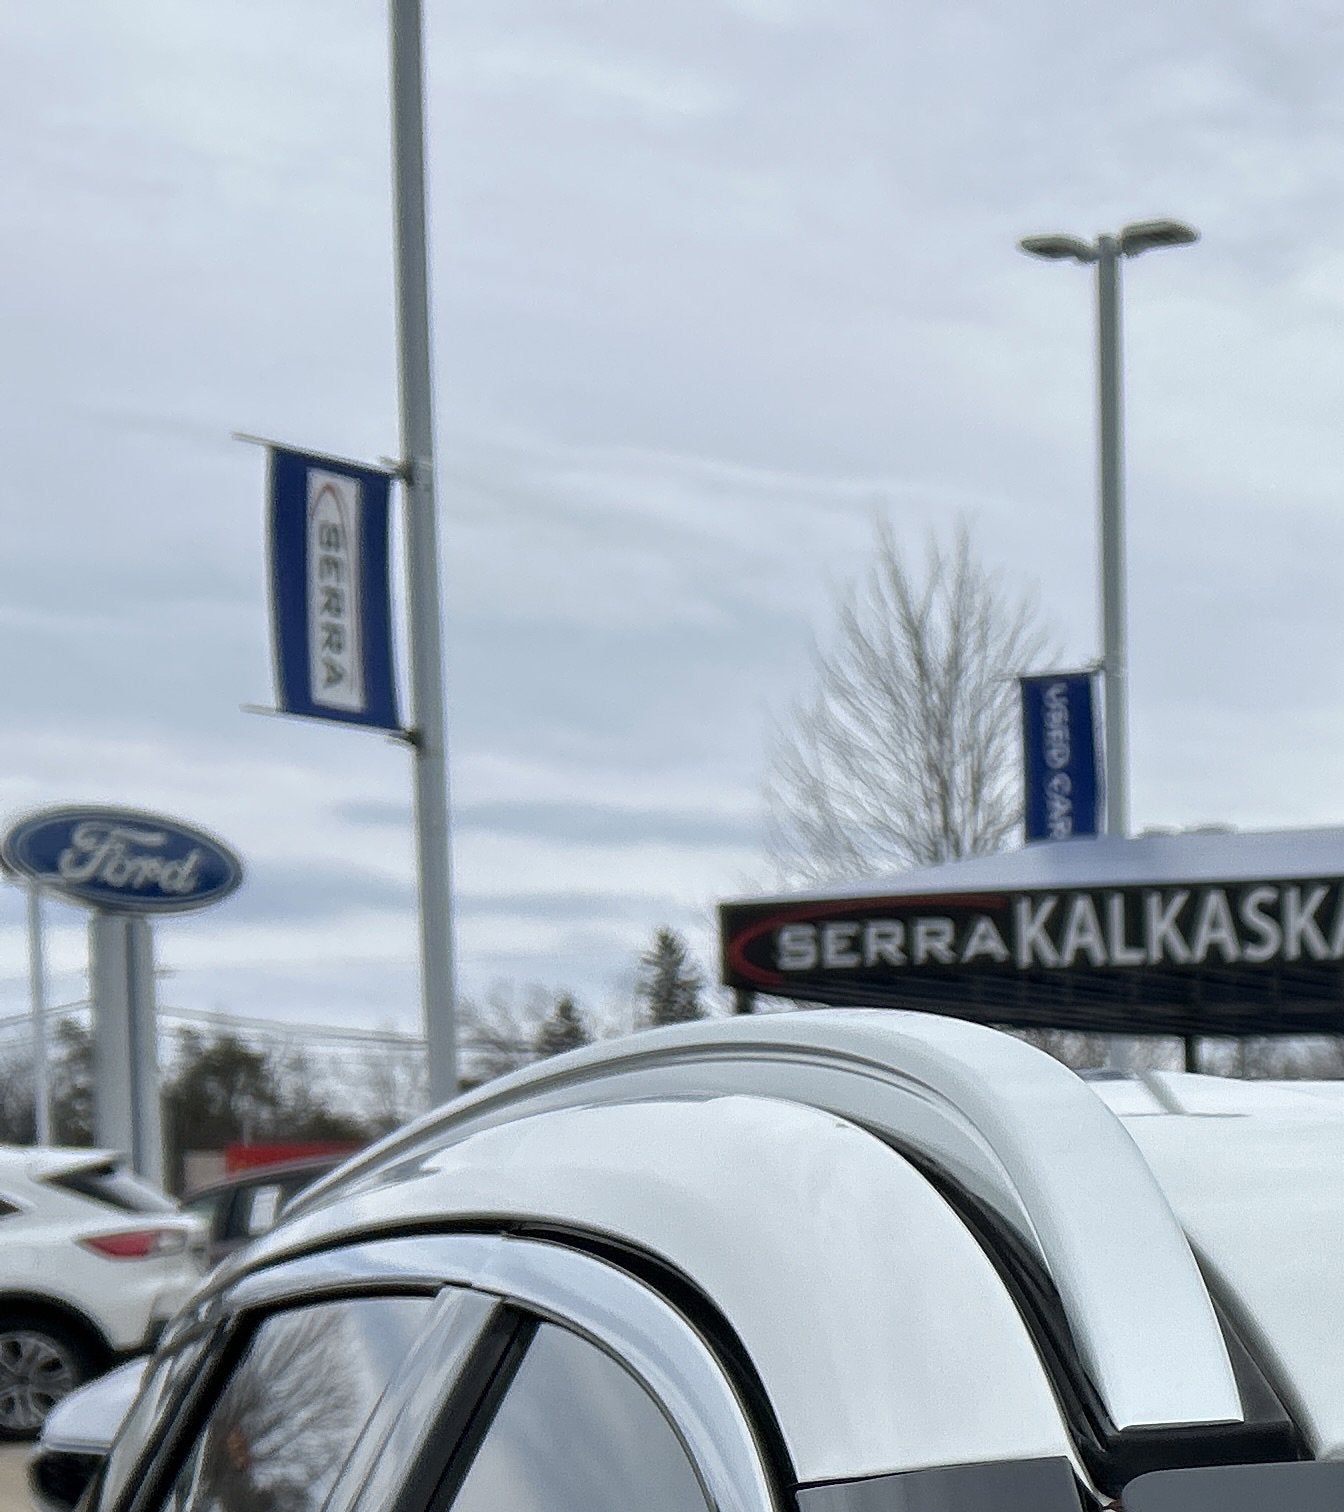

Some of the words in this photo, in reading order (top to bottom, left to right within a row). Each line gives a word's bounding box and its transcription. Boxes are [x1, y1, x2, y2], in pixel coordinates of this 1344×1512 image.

[318, 522, 346, 688] SERRA
[1044, 682, 1070, 769] USED
[58, 823, 198, 893] Ford
[775, 915, 1008, 971] SERRA
